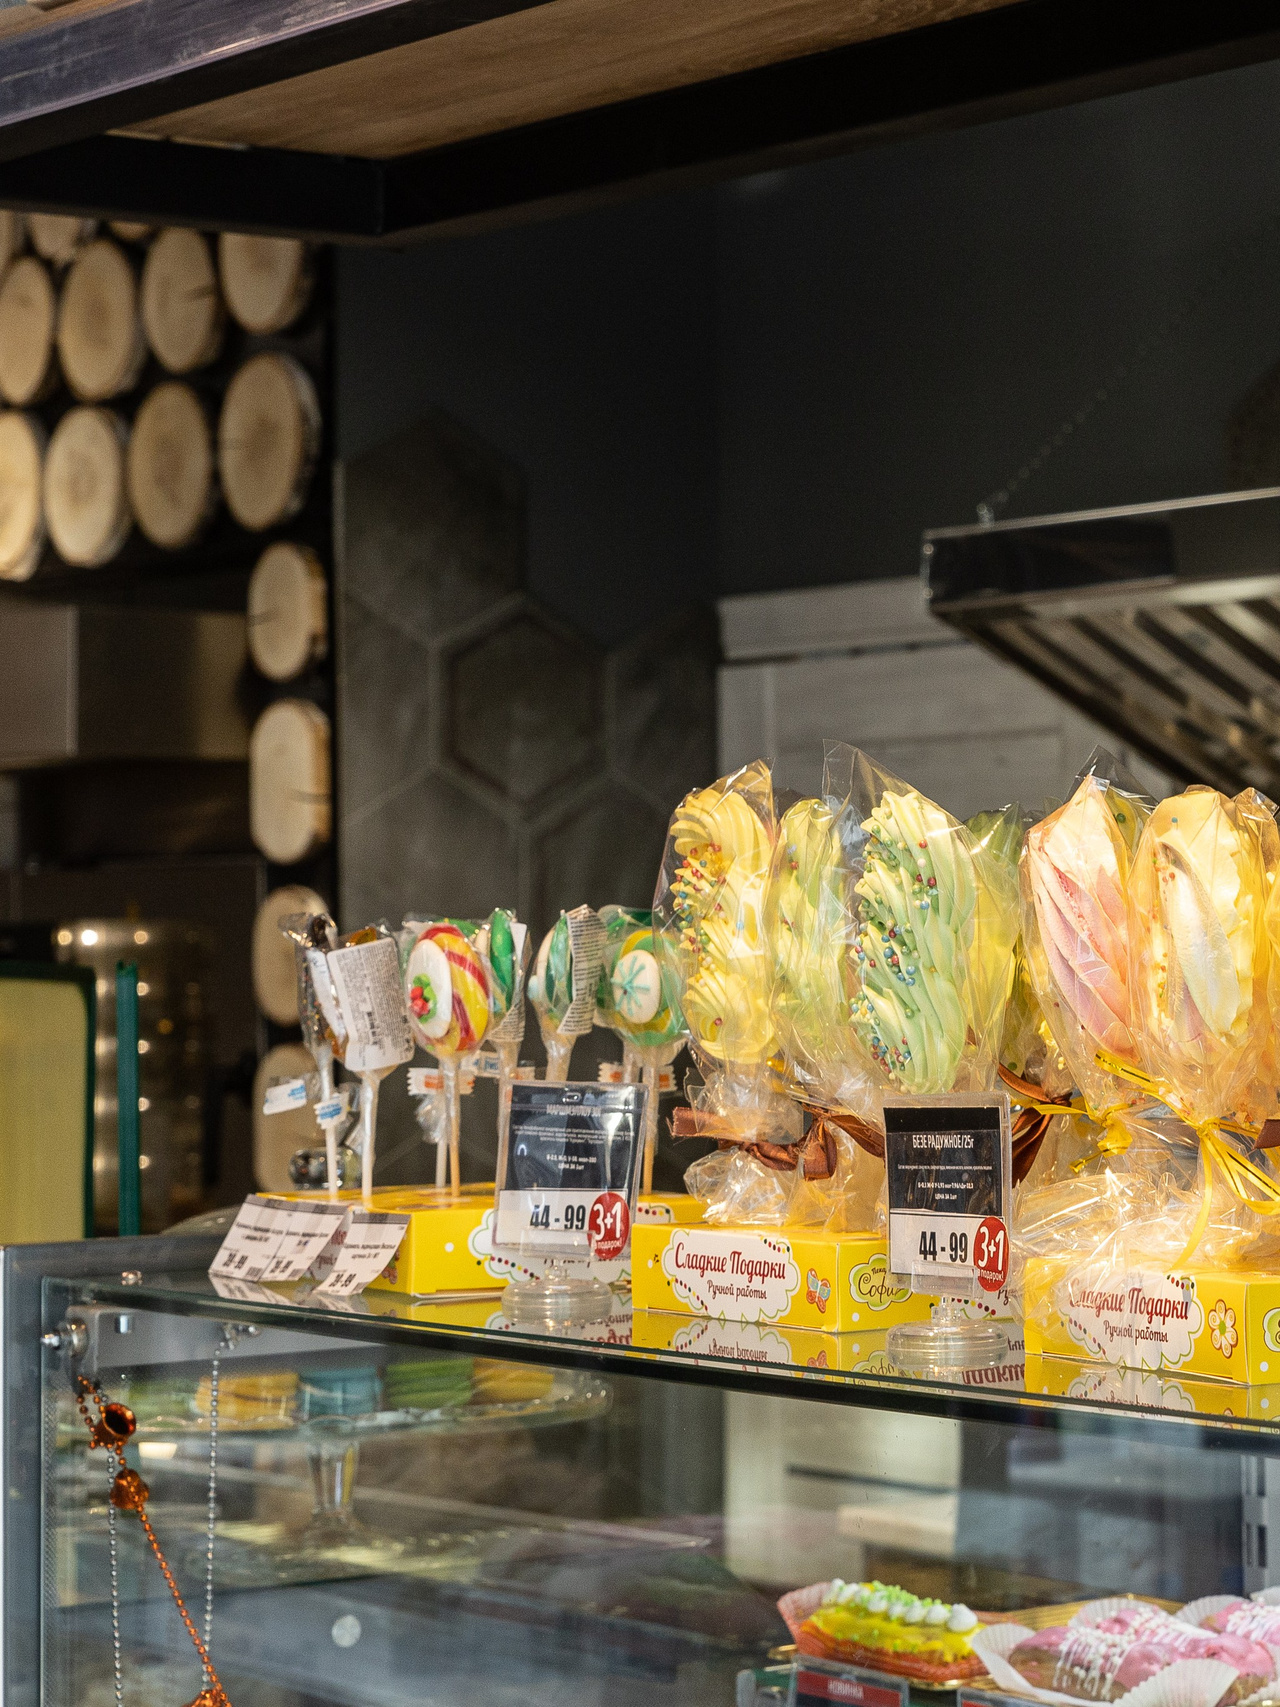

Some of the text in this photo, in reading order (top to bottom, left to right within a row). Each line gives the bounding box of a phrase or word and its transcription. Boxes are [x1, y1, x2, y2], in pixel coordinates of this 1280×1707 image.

[912, 1135, 975, 1149] БЕЗЕ РАДУЖНОЕ/25г
[530, 1205, 550, 1228] 44
[564, 1205, 585, 1230] 99
[593, 1202, 622, 1240] 3+1
[674, 1242, 786, 1284] Сладкие Подарки
[919, 1231, 937, 1261] 44
[949, 1232, 968, 1263] 99
[978, 1226, 1004, 1270] 3+1
[707, 1279, 767, 1302] Ручной работы
[1069, 1277, 1189, 1325] Сладкие Подарки
[1103, 1320, 1169, 1345] Ручной работы
